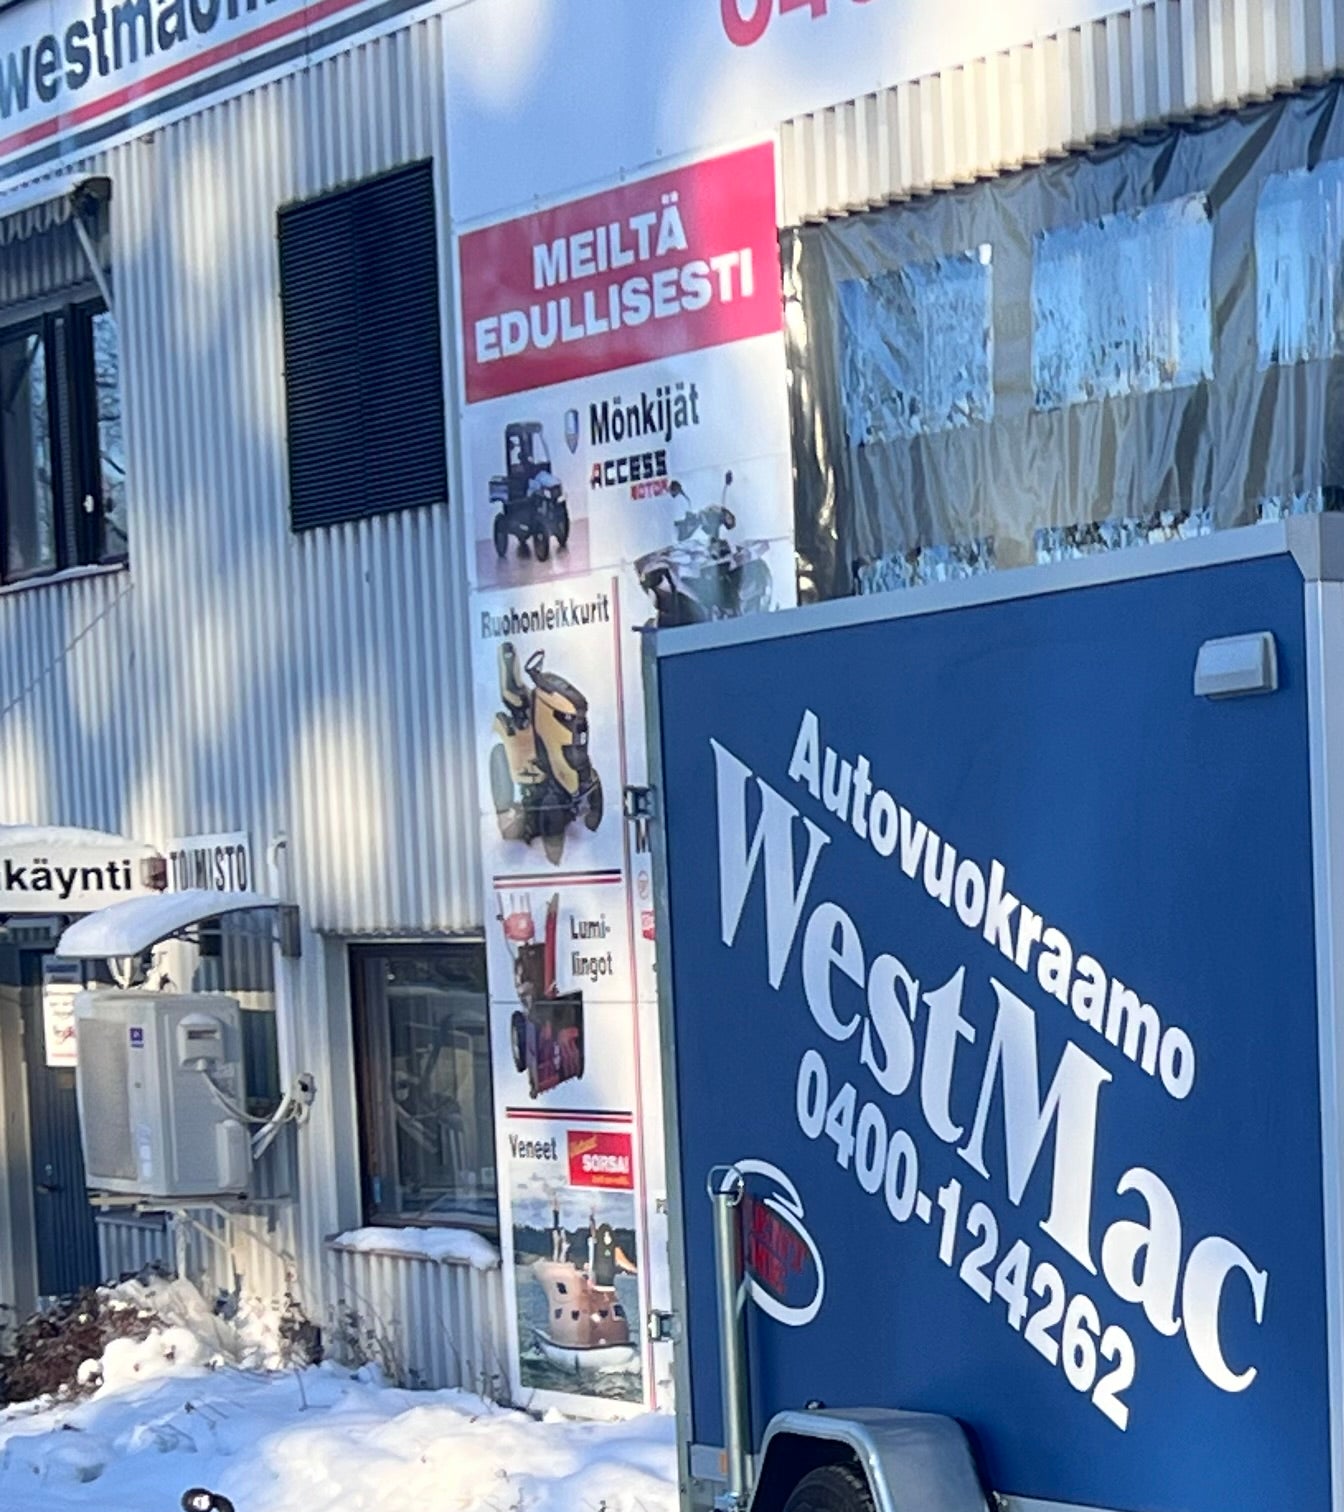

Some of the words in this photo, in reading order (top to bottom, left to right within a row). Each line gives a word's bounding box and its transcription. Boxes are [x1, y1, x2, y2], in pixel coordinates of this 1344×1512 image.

[532, 192, 688, 290] MEILTÄ
[475, 247, 753, 364] EDULLISESTI
[589, 382, 700, 445] Mönkijät
[591, 449, 668, 490] ACCESS
[481, 594, 610, 638] Ruohonleikkurit
[0, 858, 132, 900] käynti
[170, 844, 247, 893] TOIMISTO
[788, 708, 1195, 1099] Autovuokraamo
[572, 951, 613, 983] lingot
[710, 738, 1268, 1393] WestMac
[509, 1134, 558, 1161] Veneet
[796, 1049, 1136, 1430] 0400-124262
